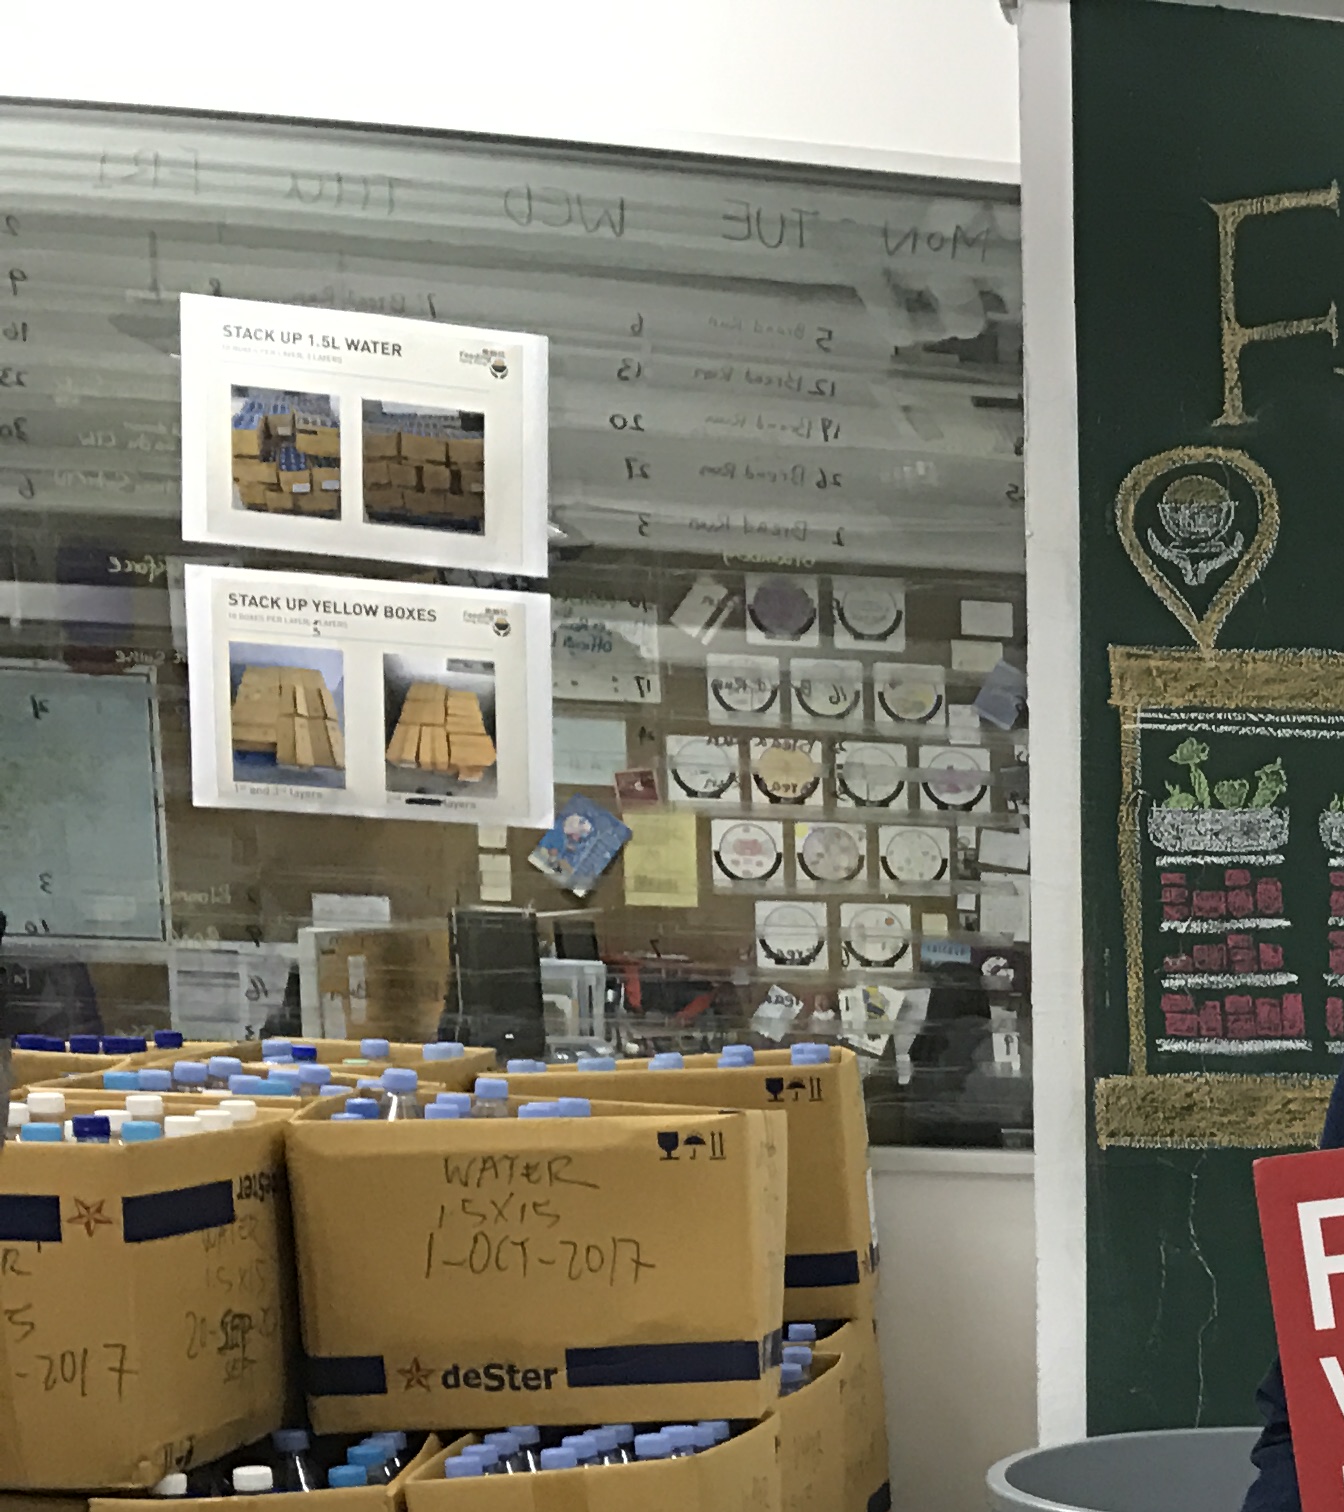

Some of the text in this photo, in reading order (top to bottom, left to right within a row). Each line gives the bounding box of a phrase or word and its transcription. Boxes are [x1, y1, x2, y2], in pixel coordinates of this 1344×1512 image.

[222, 324, 275, 343] STACK
[280, 331, 303, 345] UP
[308, 333, 341, 351] 1.5L
[344, 337, 403, 358] WATER
[228, 592, 437, 623] STACK UP YELLOW BOXES
[443, 1155, 600, 1190] WATER
[441, 1358, 559, 1396] deSter
